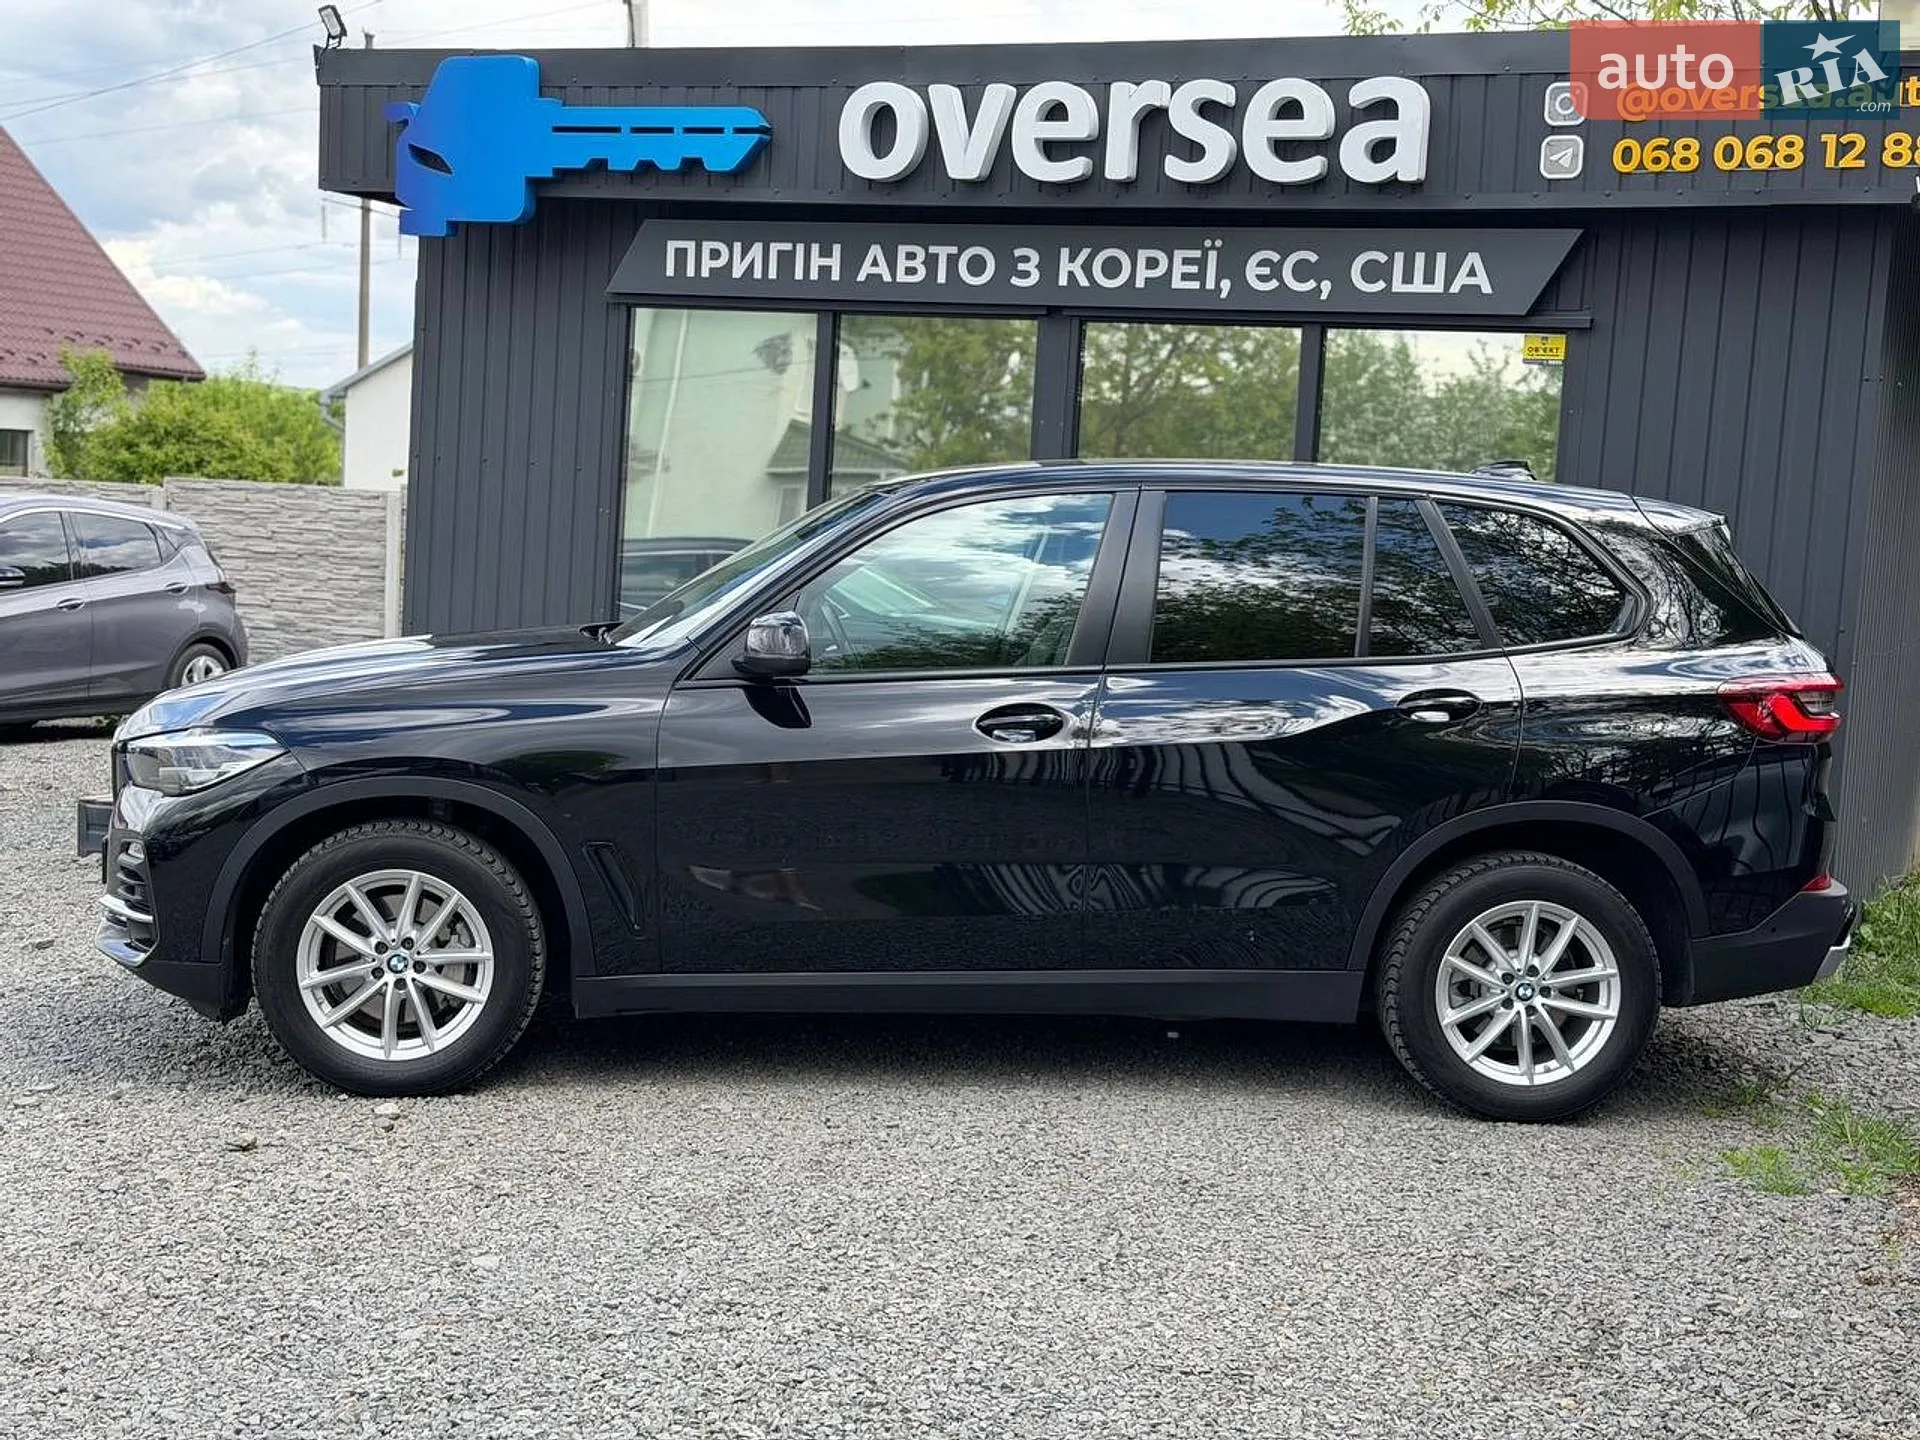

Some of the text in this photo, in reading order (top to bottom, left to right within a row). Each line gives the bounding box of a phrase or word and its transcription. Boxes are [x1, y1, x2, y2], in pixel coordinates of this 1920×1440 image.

[838, 76, 1431, 184] oversea
[1612, 131, 1920, 173] 068 068 12 8
[665, 238, 1495, 300] ПРИГІН АВТО З КОРЕЇ, ЄС, США
